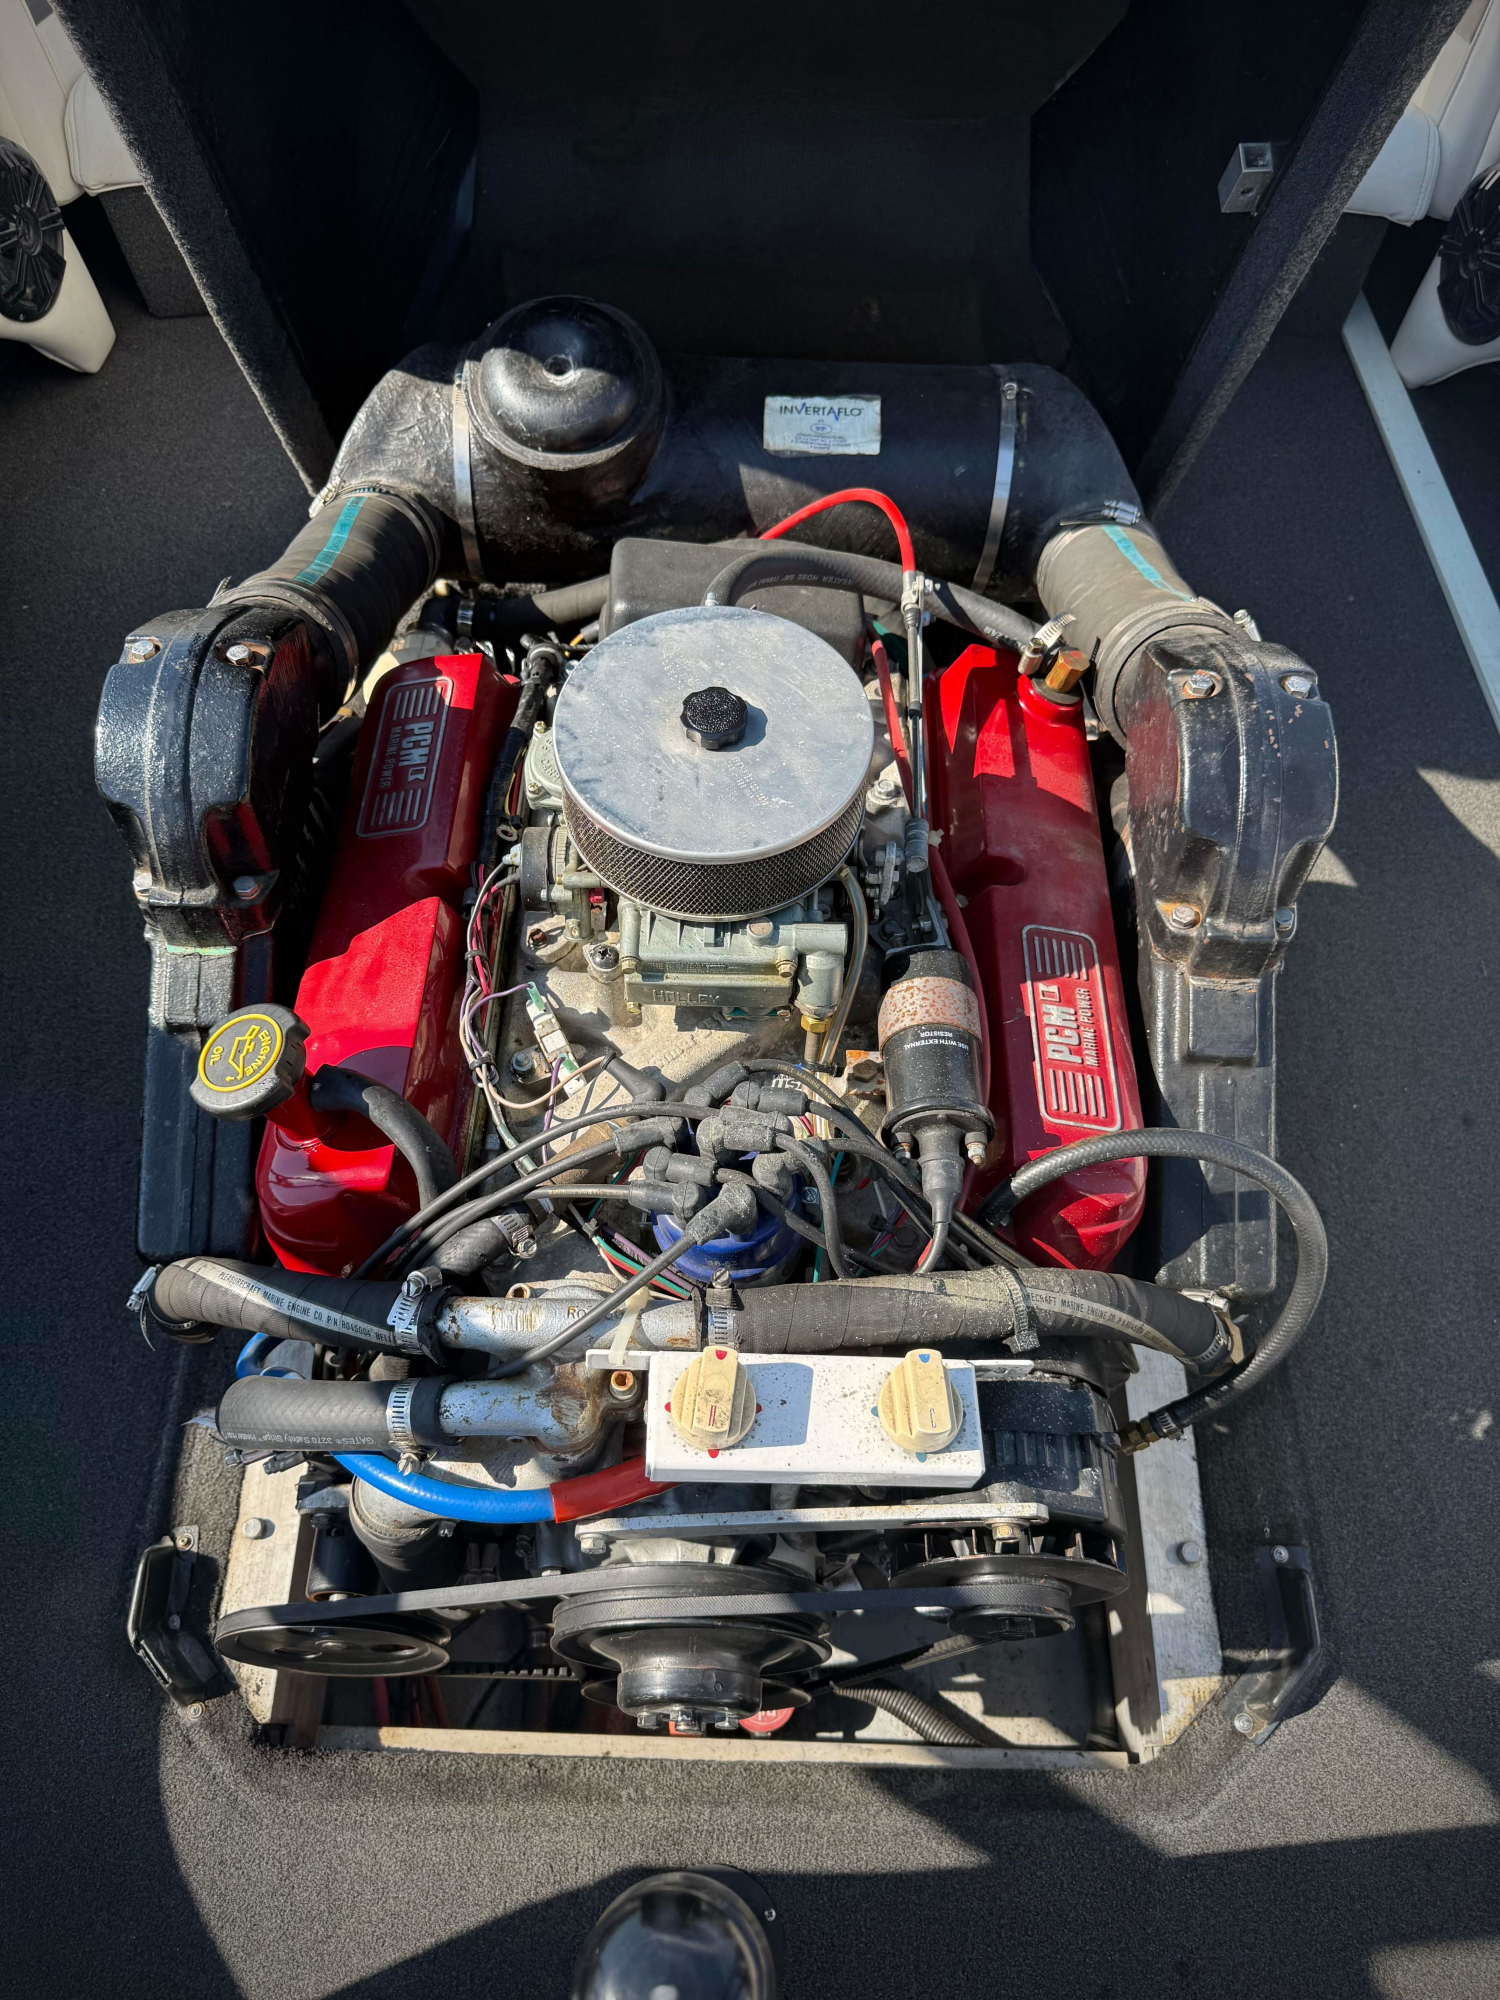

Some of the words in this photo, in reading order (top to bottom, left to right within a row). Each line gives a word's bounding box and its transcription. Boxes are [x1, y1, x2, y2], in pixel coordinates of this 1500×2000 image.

[780, 402, 863, 421] INVERTAFLO
[384, 726, 402, 758] MARINE
[398, 721, 435, 766] PCM
[380, 758, 396, 788] POWER
[653, 989, 720, 1004] HOLLEY
[1075, 987, 1095, 1024] POWER
[903, 1038, 938, 1050] EXTERNAL
[920, 1030, 953, 1038] RESISTOR
[940, 1038, 957, 1046] WITH
[1042, 1005, 1083, 1064] PCM
[1080, 1026, 1100, 1067] MARINE
[210, 1046, 224, 1066] OIL
[244, 1029, 272, 1077] ENGINE
[218, 1271, 262, 1294] PLEASURECRAFT
[262, 1290, 285, 1307] MARINE
[288, 1301, 311, 1317] ENGINE
[313, 1310, 324, 1322] CO.
[327, 1315, 338, 1327] P/N
[1060, 1298, 1084, 1313] MARINE
[1087, 1305, 1108, 1320] ENGINE
[284, 1433, 310, 1444] Safety
